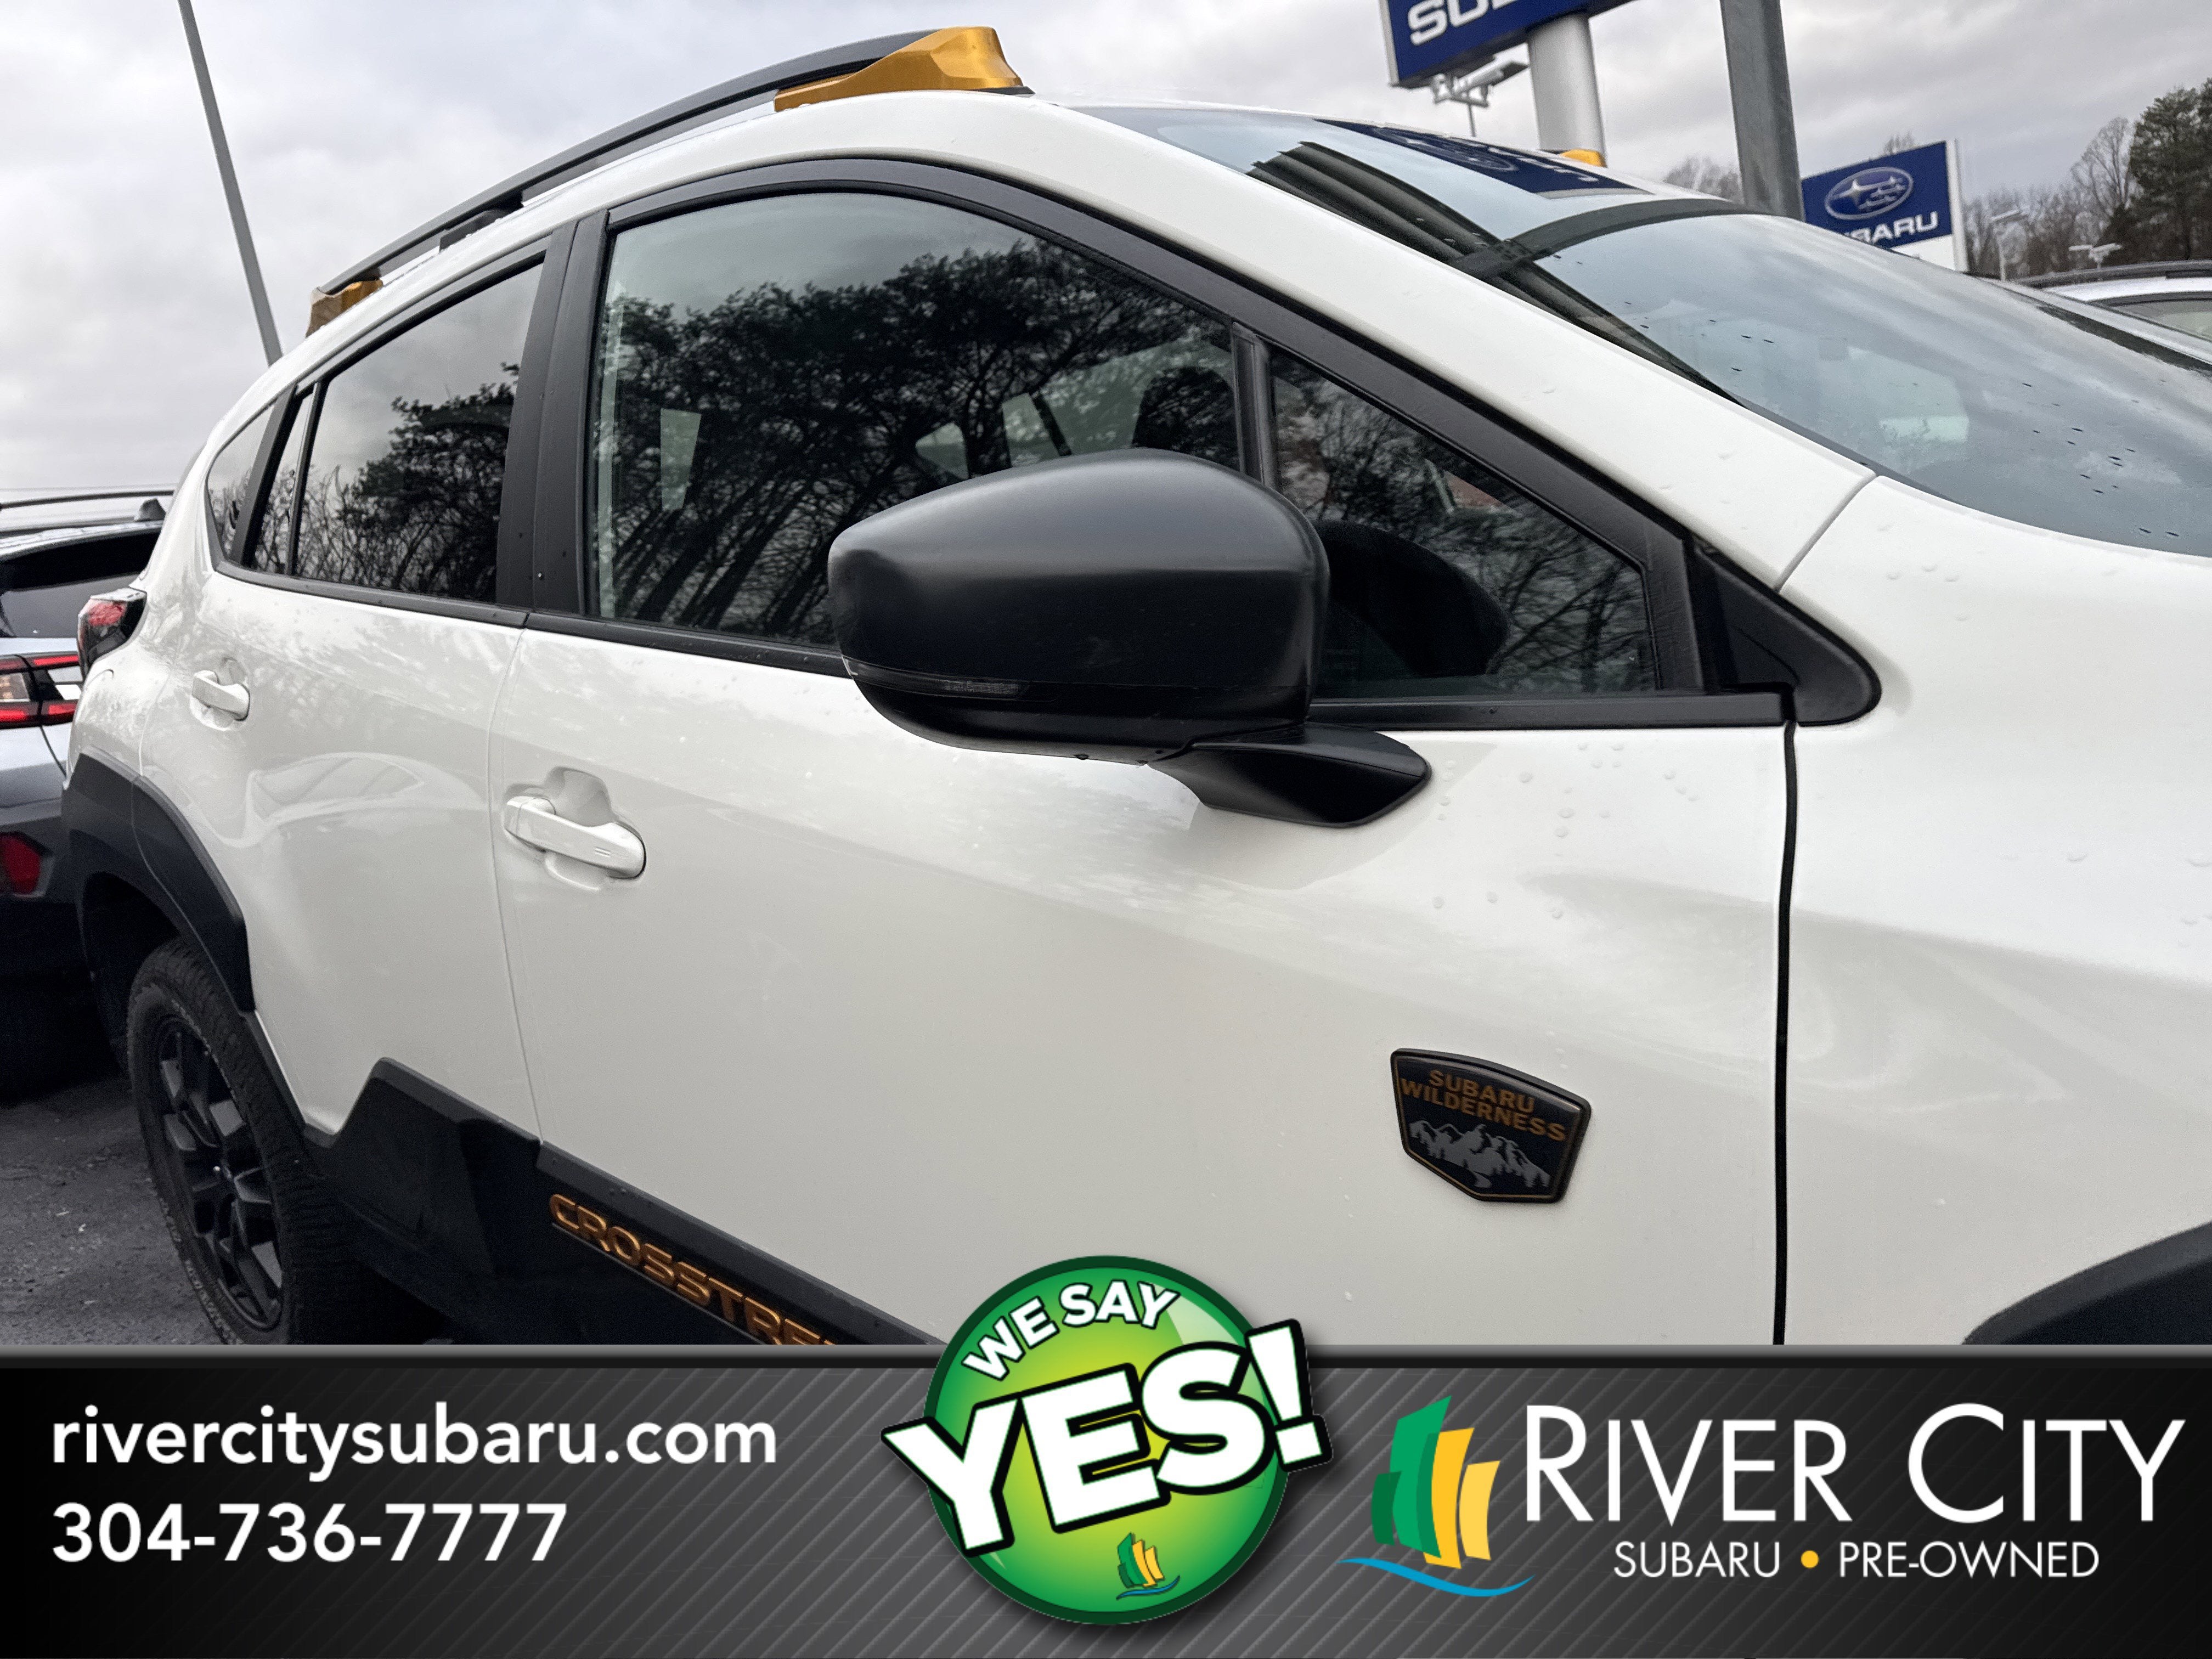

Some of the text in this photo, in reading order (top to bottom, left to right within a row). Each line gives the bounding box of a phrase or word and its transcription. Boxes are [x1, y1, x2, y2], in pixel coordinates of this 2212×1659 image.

[1402, 1079, 1566, 1141] WILDERNESS
[1429, 1070, 1534, 1113] SUBARU
[550, 1193, 837, 1345] CROSSTRE
